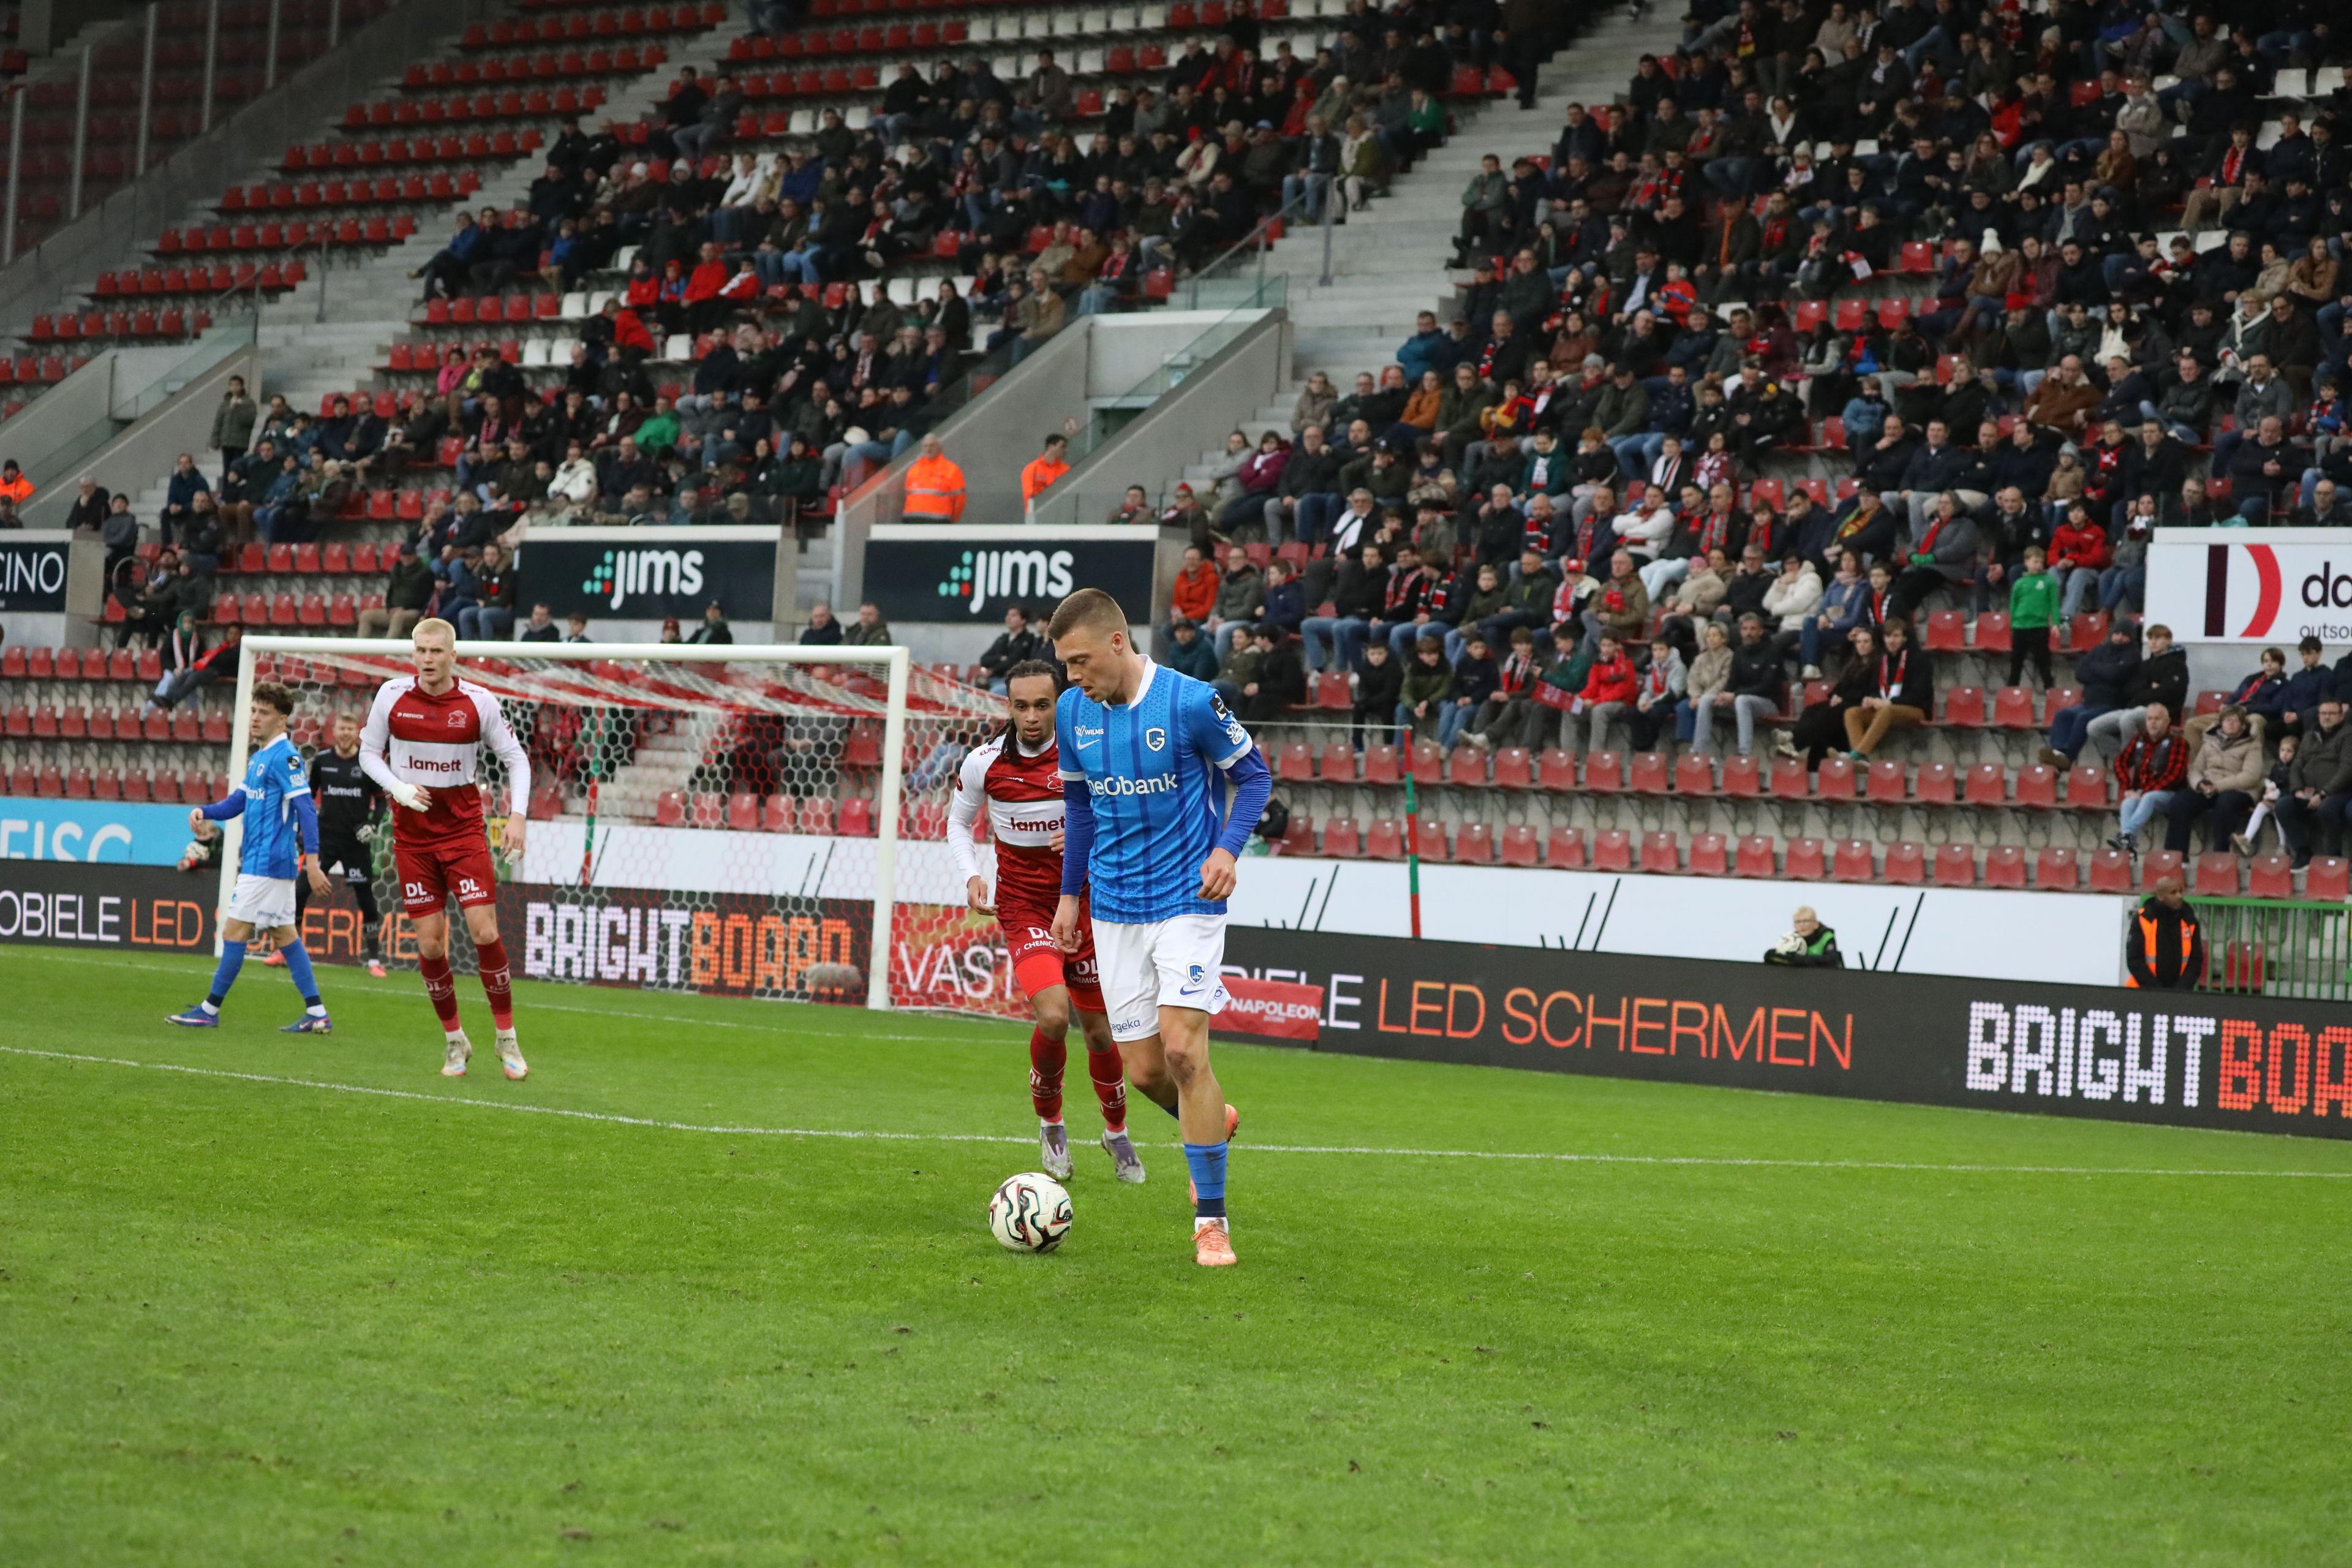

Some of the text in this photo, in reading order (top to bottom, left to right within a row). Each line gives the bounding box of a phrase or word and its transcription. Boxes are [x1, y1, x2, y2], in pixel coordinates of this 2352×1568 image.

[0, 551, 65, 594] INO
[611, 549, 704, 611] jims
[969, 550, 1074, 614] jims
[2299, 622, 2352, 639] outso
[1010, 816, 1066, 832] lamet
[405, 881, 428, 897] DL
[459, 878, 480, 894] DL
[130, 897, 203, 946] LED
[1023, 940, 1059, 950] CHEMICA
[1069, 973, 1101, 984] CHEMICA
[1230, 997, 1321, 1020] NAPOLEON
[1377, 978, 1486, 1039] LED
[1502, 987, 1853, 1070] SCHERMEN
